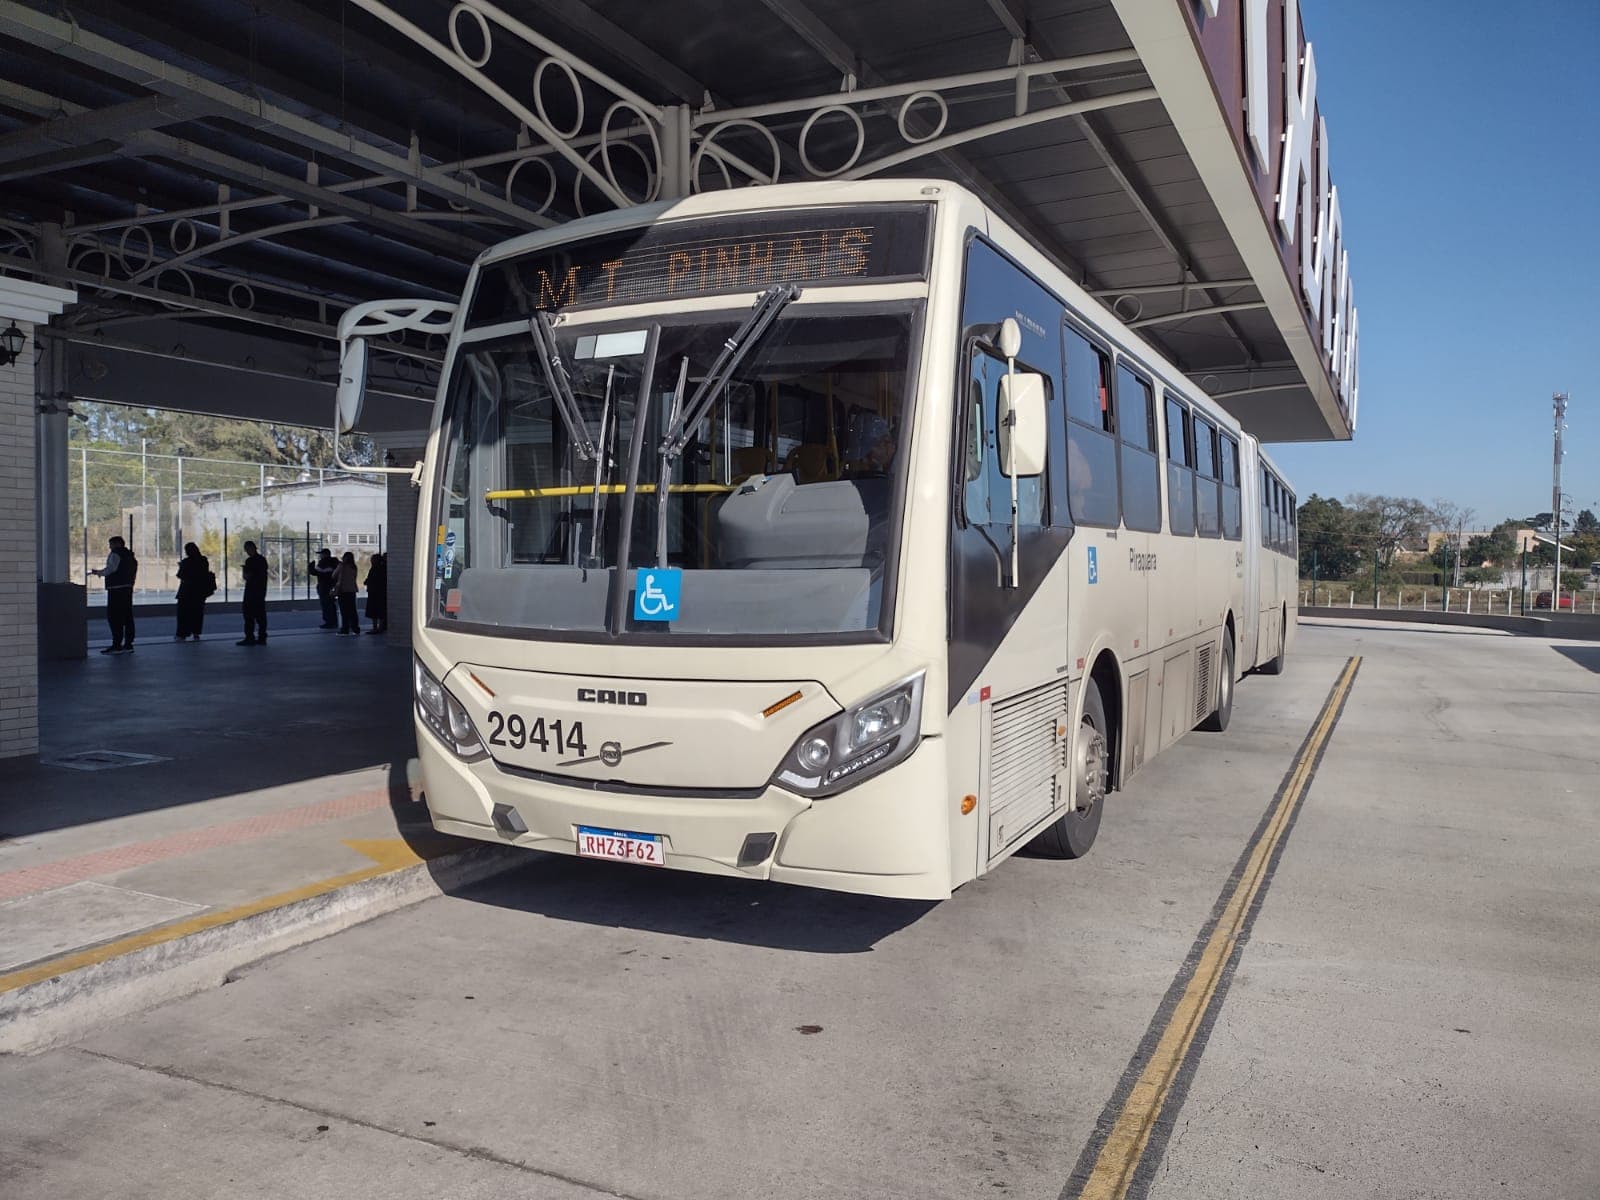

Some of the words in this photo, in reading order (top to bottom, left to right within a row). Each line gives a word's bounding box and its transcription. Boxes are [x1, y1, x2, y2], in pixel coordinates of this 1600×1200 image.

[667, 229, 868, 296] PINHAIS
[577, 688, 648, 707] CAIO
[487, 710, 588, 758] 29414
[586, 835, 656, 862] RHZ3F62
